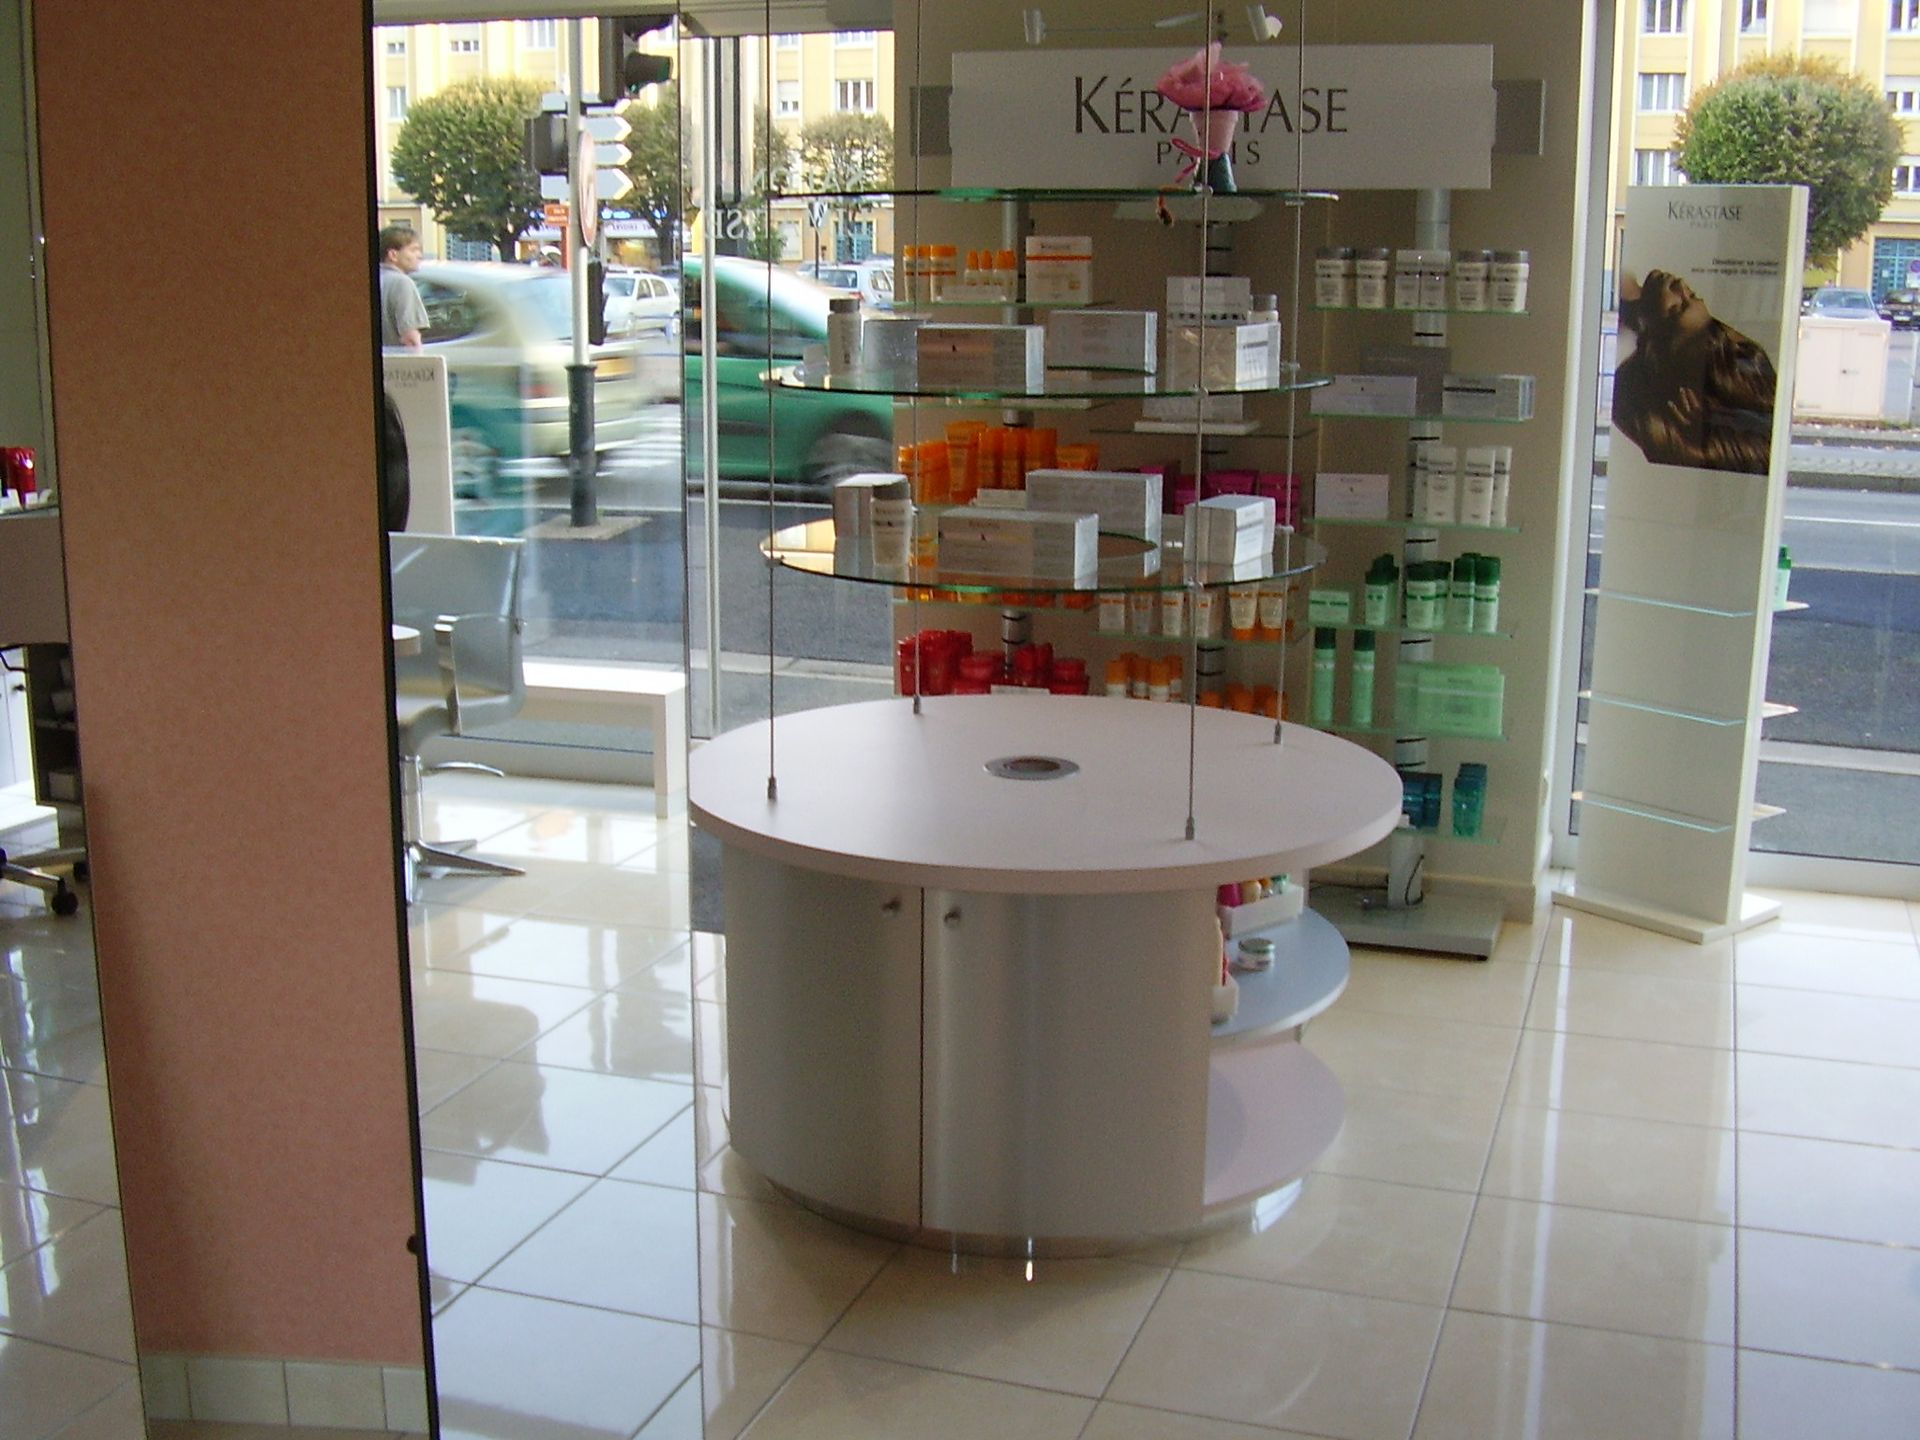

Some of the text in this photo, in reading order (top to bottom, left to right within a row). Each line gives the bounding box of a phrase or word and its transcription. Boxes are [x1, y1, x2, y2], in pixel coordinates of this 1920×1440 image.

[1074, 75, 1349, 134] KÉRASE
[1156, 140, 1261, 166] PAIS
[1667, 201, 1743, 221] KÉRASTASE
